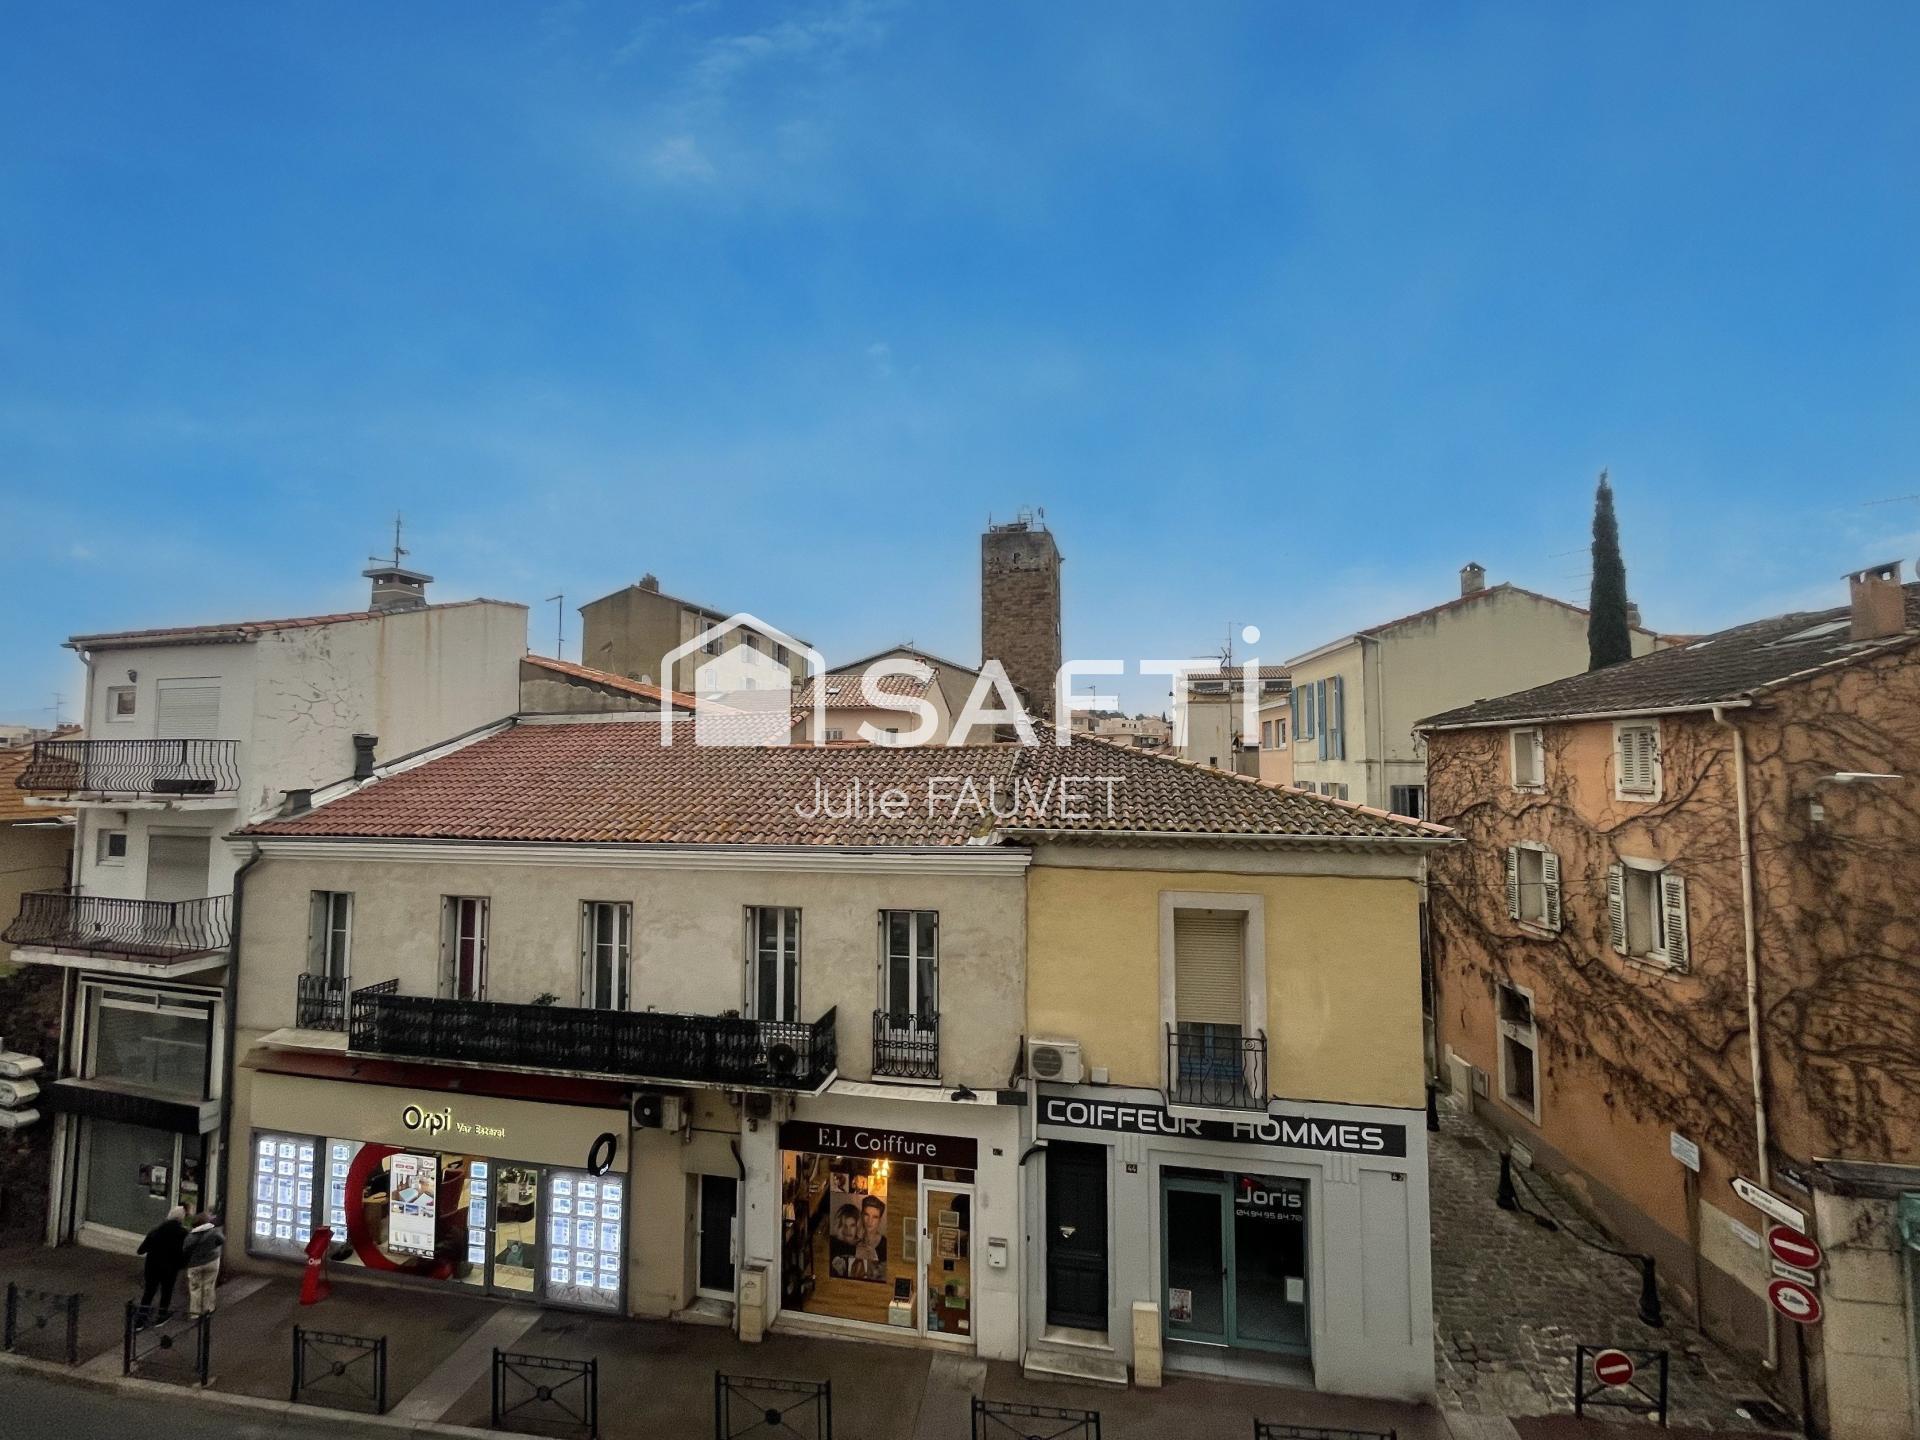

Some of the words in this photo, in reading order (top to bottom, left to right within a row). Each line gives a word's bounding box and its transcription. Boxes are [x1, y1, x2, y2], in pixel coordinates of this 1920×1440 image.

[402, 1104, 451, 1136] Orpi
[1047, 1100, 1203, 1135] COIFFEUR
[1233, 1119, 1385, 1150] HOMMES
[854, 1132, 937, 1157] Coiffure
[1236, 1186, 1302, 1208] Joris
